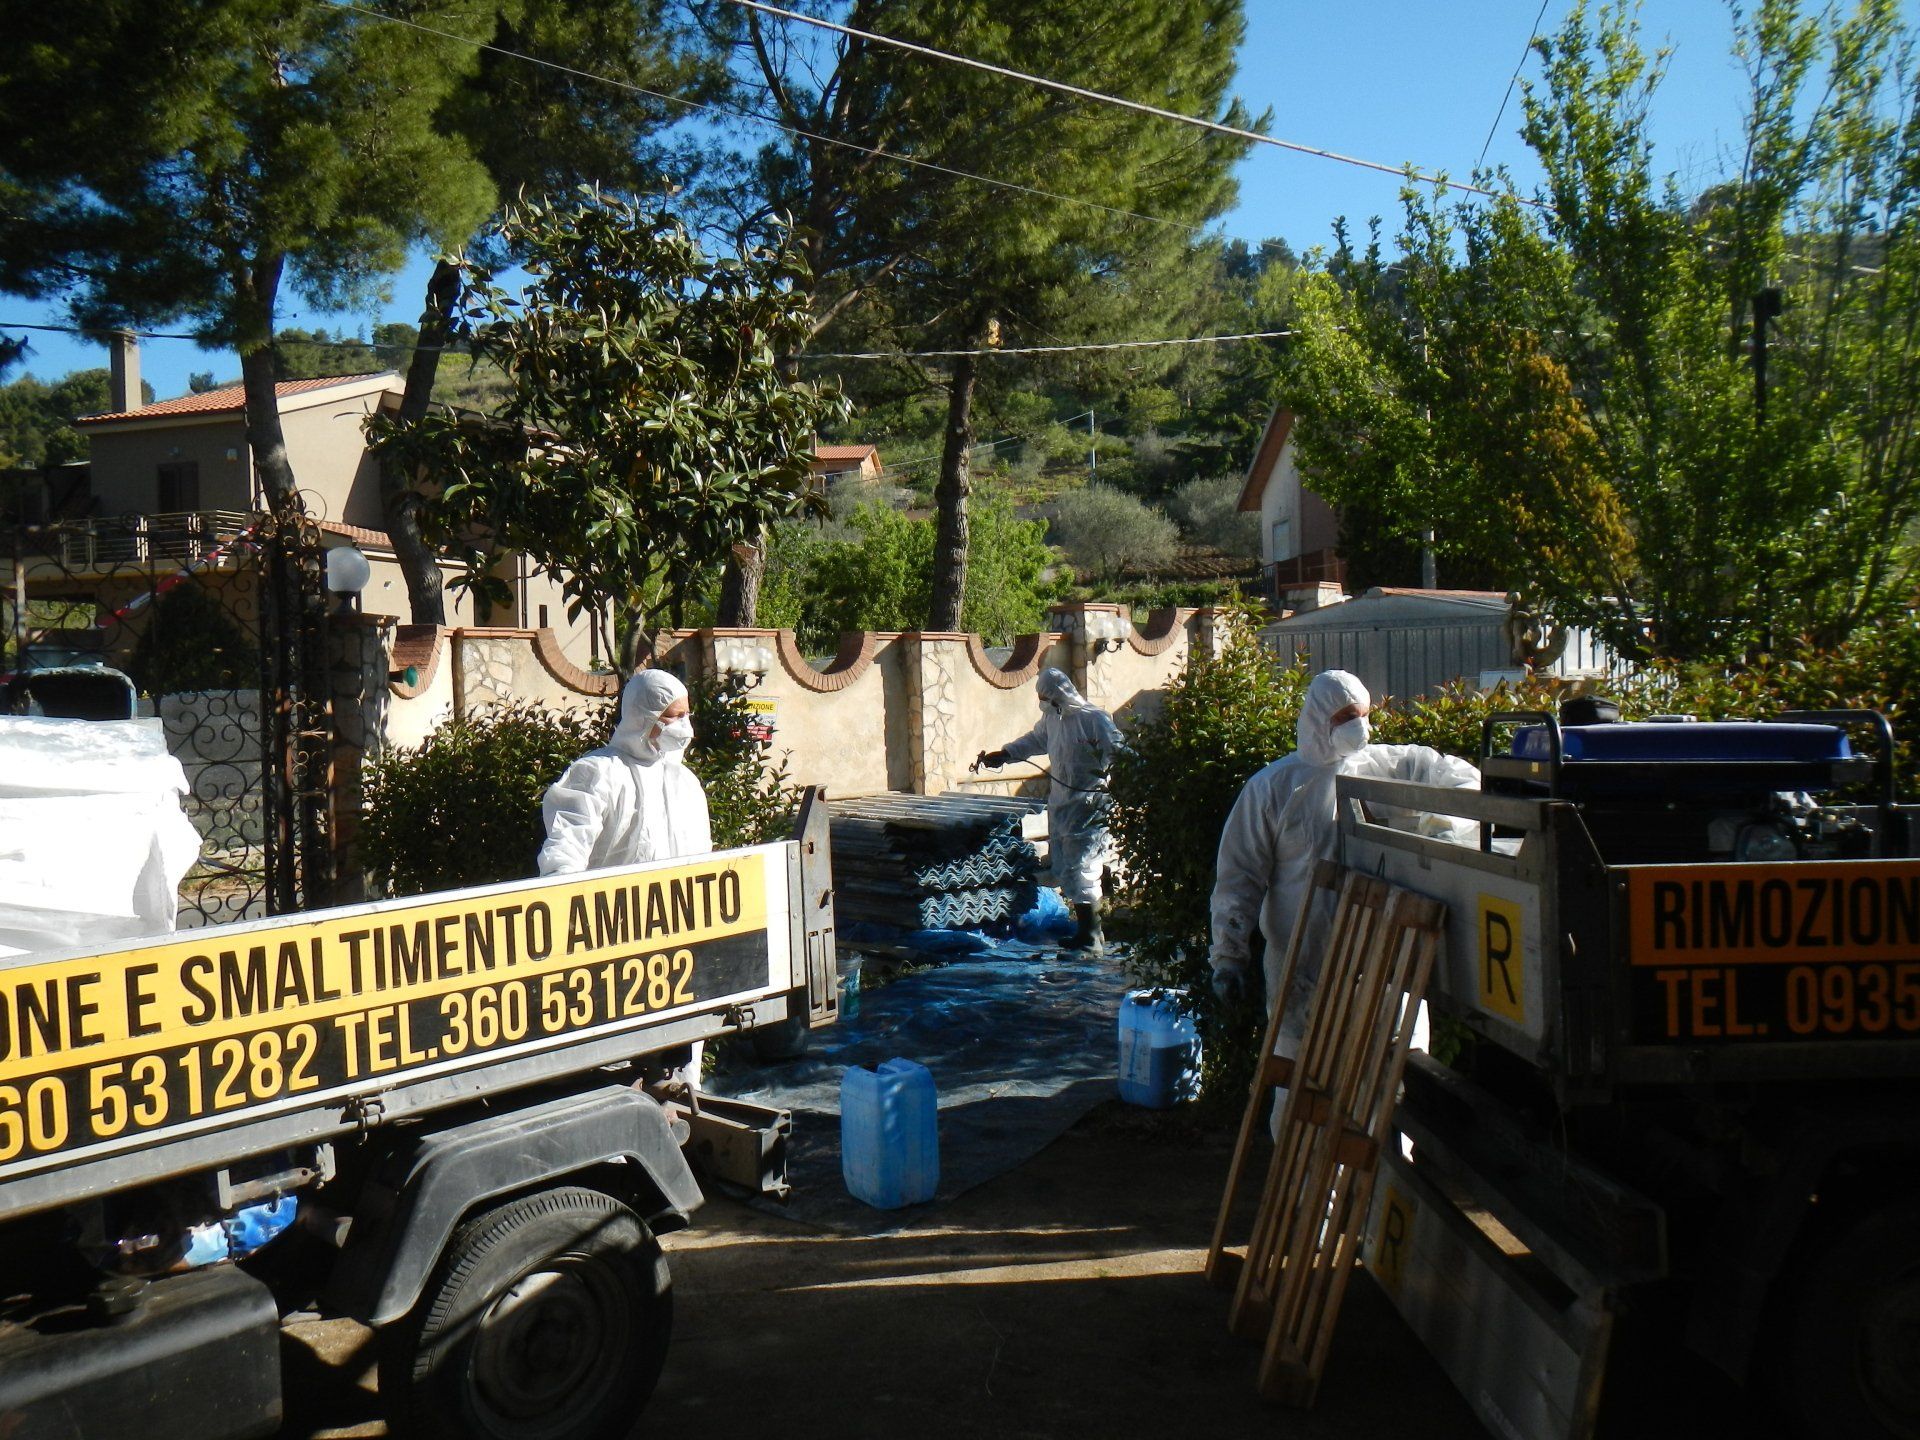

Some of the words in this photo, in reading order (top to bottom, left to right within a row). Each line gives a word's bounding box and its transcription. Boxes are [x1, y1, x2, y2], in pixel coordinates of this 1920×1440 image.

[1485, 910, 1517, 1005] R
[1654, 877, 1920, 949] RIMOZION
[0, 972, 105, 1063] NE
[125, 963, 161, 1037] E
[179, 901, 553, 1027] SMALTIMENTO
[567, 870, 740, 954] AMIANTO
[1657, 969, 1767, 1037] TEL.
[1786, 965, 1920, 1034] 0935
[91, 1024, 319, 1136] 531282
[541, 949, 695, 1033] 531282
[1381, 1201, 1404, 1285] R
